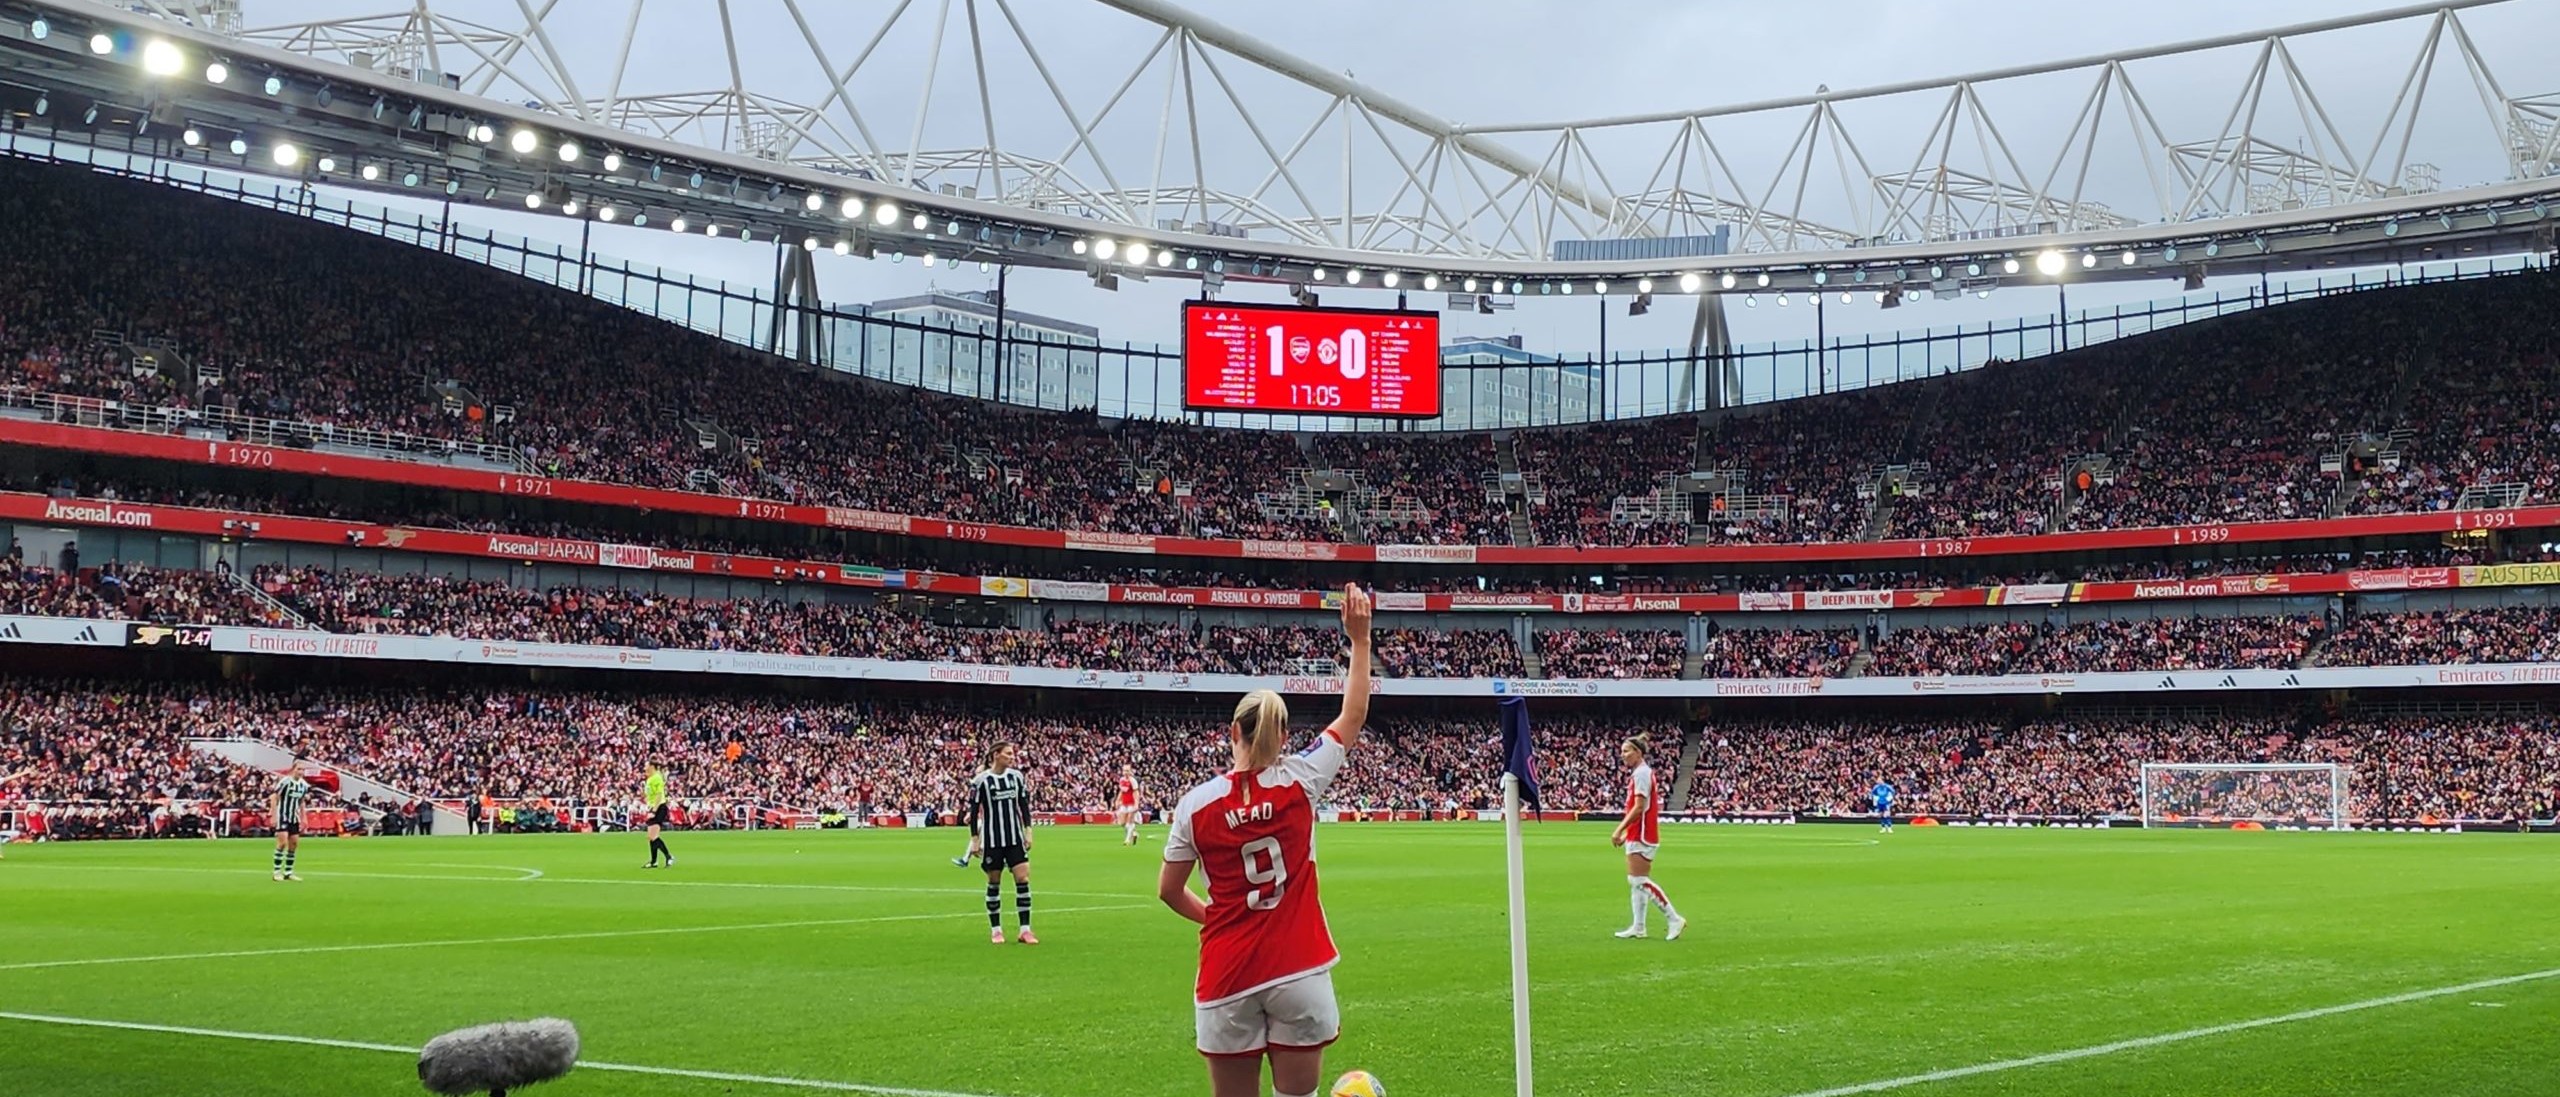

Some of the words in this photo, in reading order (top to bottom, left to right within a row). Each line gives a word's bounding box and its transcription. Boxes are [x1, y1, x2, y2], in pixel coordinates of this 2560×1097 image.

[1266, 325, 1284, 376] 1
[1340, 328, 1366, 379] 0
[1291, 384, 1341, 406] 17:05
[228, 447, 273, 466] 1970
[515, 478, 552, 495] 1971
[45, 500, 151, 527] Arsenal.com
[755, 504, 786, 520] 1971
[2474, 512, 2516, 528] 1991
[959, 526, 987, 540] 1979
[2191, 527, 2229, 543] 1989
[488, 537, 539, 556] Arsenal
[547, 543, 595, 561] JAPAN
[1414, 548, 1423, 558] IS
[1424, 548, 1473, 559] PERMANENT
[1936, 541, 1972, 555] 1987
[615, 546, 650, 567] CANADA
[650, 552, 694, 570] Arsenal
[1123, 588, 1194, 603] Arsenal.com
[2134, 581, 2217, 597] Arsenal.com
[1211, 590, 1248, 604] ARSENAL
[1264, 592, 1300, 605] SWEDEN
[1453, 595, 1496, 604] HUNGARIAN
[1497, 595, 1533, 604] GOONERS
[1633, 597, 1680, 610] Arsenal
[1822, 595, 1844, 606] DEEP
[1846, 595, 1856, 605] IN
[1858, 594, 1875, 604] THE
[173, 629, 212, 646] 12:47
[250, 633, 317, 652] Emirates
[323, 637, 340, 653] FLY
[342, 638, 378, 656] BETTER
[732, 657, 836, 673] hospitality.arsenal.com
[930, 667, 973, 681] Emirates
[976, 669, 988, 681] FLY
[988, 670, 1010, 683] BETTER
[2438, 668, 2506, 683] Emirates
[2512, 667, 2529, 681] FLY
[1716, 683, 1772, 695] Emirates
[1777, 683, 1791, 694] FLY
[1224, 802, 1273, 830] MEAD
[1241, 835, 1288, 910] 9
